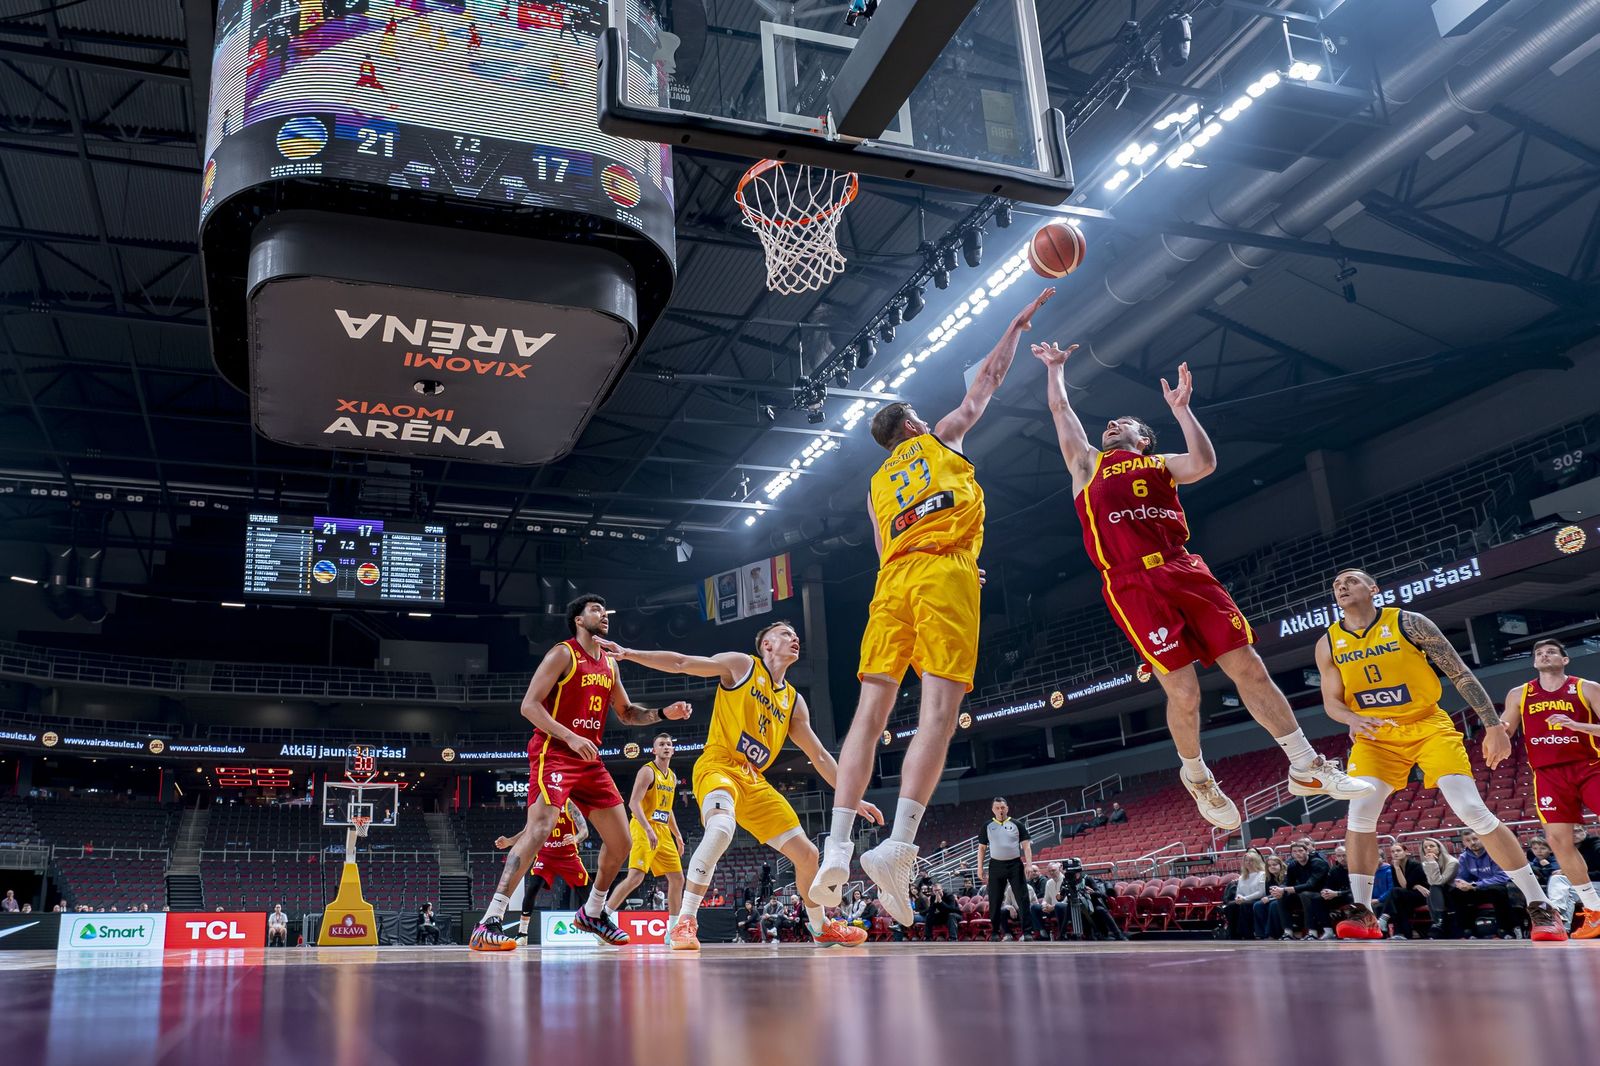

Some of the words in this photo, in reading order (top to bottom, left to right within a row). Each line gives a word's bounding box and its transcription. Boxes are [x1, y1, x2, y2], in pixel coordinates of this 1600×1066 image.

[357, 128, 394, 157] 21
[453, 135, 481, 153] 7.2
[270, 163, 323, 178] UKRAINE
[532, 155, 570, 183] 17
[616, 208, 643, 230] SPAIN
[334, 309, 557, 358] ARĒNA
[402, 352, 532, 379] XIAOMI
[335, 399, 455, 422] XIAOMI
[323, 416, 505, 449] ARĒNA
[1552, 450, 1583, 471] 303
[889, 458, 931, 509] 23
[1132, 478, 1149, 498] 6
[249, 514, 279, 524] UKRAINE
[895, 494, 944, 532] GGBET
[1108, 504, 1178, 524] endesa
[323, 522, 337, 535] 21
[358, 524, 373, 537] 17
[424, 526, 444, 534] SPAIN
[340, 540, 355, 550] 7.2
[721, 598, 736, 609] FIBA
[1280, 606, 1330, 637] Atklāj
[1400, 557, 1481, 604] garšas!
[1335, 641, 1401, 664] UKRAINE
[581, 673, 612, 691] ESPAÑA
[1363, 664, 1383, 684] 13
[1067, 674, 1133, 701] www.vairaksaules.lv
[1360, 689, 1402, 705] BGV
[589, 695, 603, 712] 13
[750, 686, 786, 724] UKRAINE
[976, 700, 1046, 722] www.vairaksaules.lv
[1528, 699, 1575, 715] ESPAÑA
[63, 737, 144, 750] www.vairaksaules.lv
[169, 743, 246, 754] www.vairaksaules.lv
[1530, 734, 1579, 745] endesa
[280, 744, 317, 759] Atklāj
[354, 756, 374, 771] 3.0
[552, 828, 561, 838] 10
[98, 925, 145, 939] Smart
[185, 920, 246, 940] TCL
